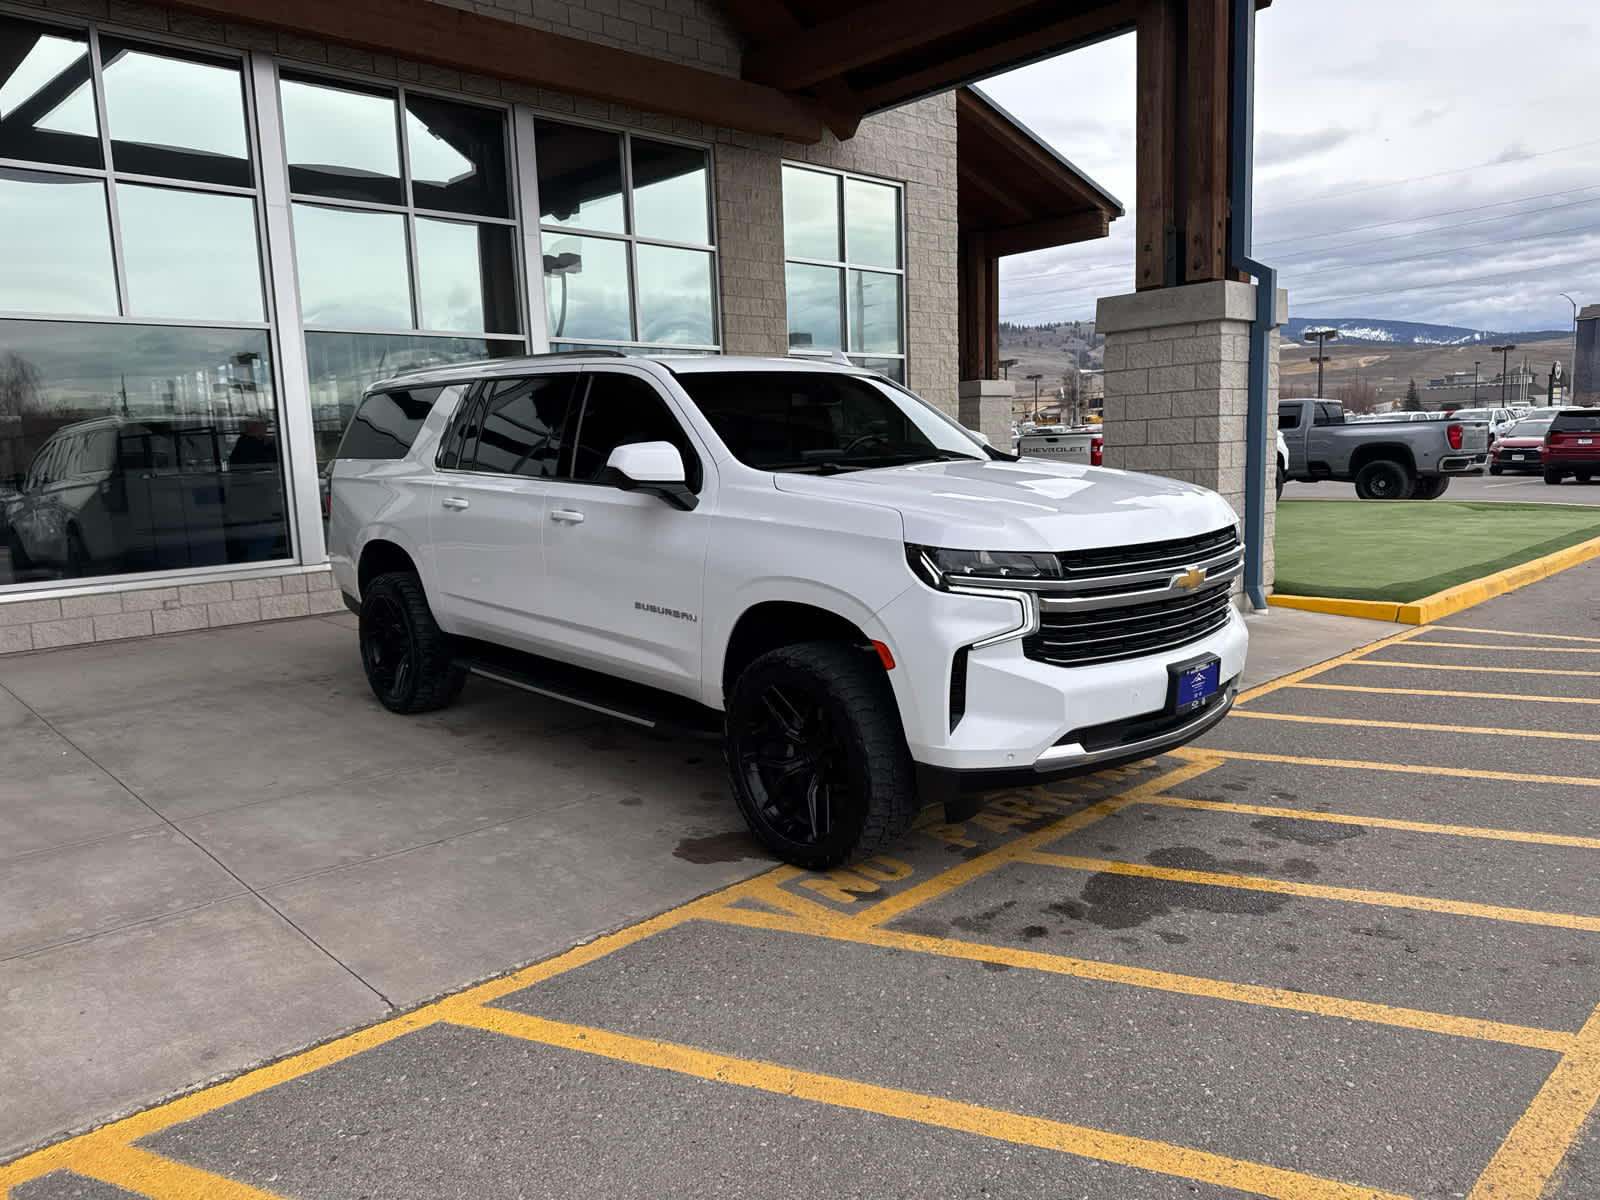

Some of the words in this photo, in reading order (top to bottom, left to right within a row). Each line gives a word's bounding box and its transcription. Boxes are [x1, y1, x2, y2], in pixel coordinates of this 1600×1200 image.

[1022, 446, 1084, 454] CHEVROLET
[634, 601, 698, 623] SUBURBAN
[798, 855, 914, 904] NO
